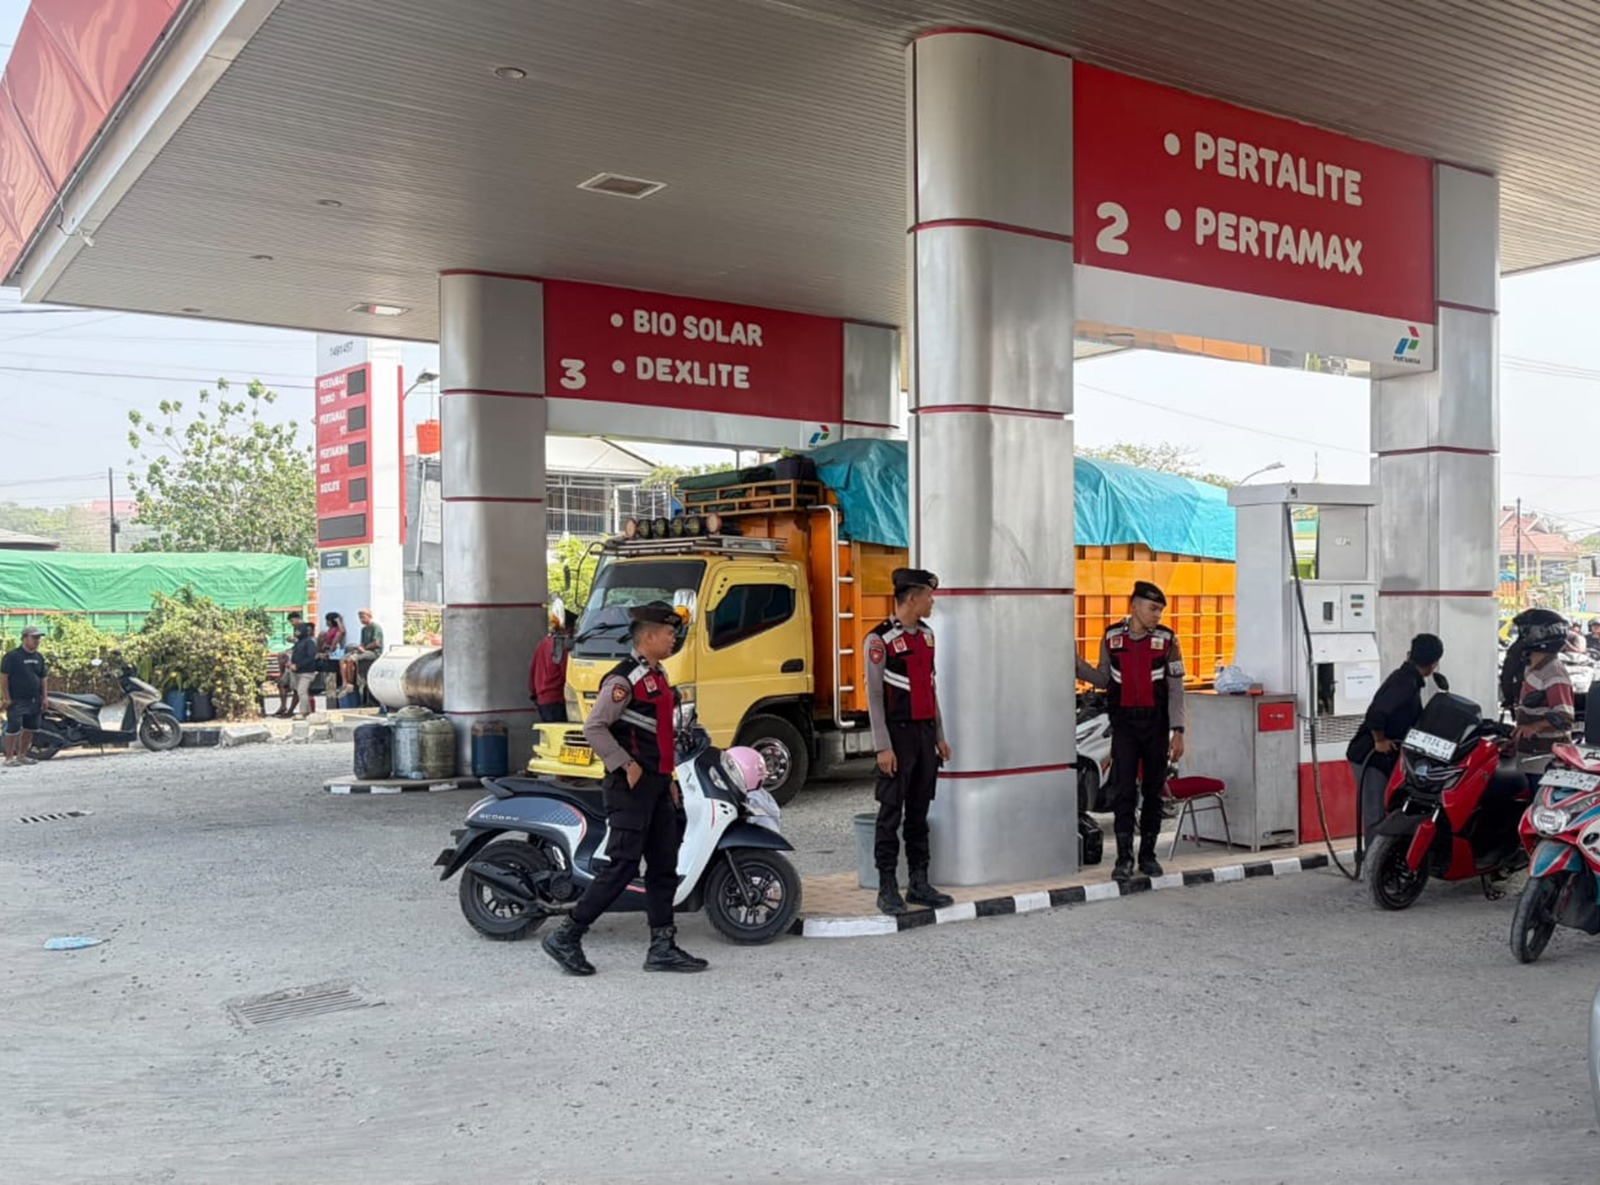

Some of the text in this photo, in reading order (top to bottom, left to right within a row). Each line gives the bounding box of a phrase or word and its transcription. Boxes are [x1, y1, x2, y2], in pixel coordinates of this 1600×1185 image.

[1194, 131, 1363, 206] PERTALITE
[1095, 201, 1129, 255] 2
[1195, 206, 1363, 276] PERTAMAX
[633, 309, 763, 347] BIO SOLAR
[559, 358, 586, 390] 3
[636, 356, 750, 389] DEXLITE
